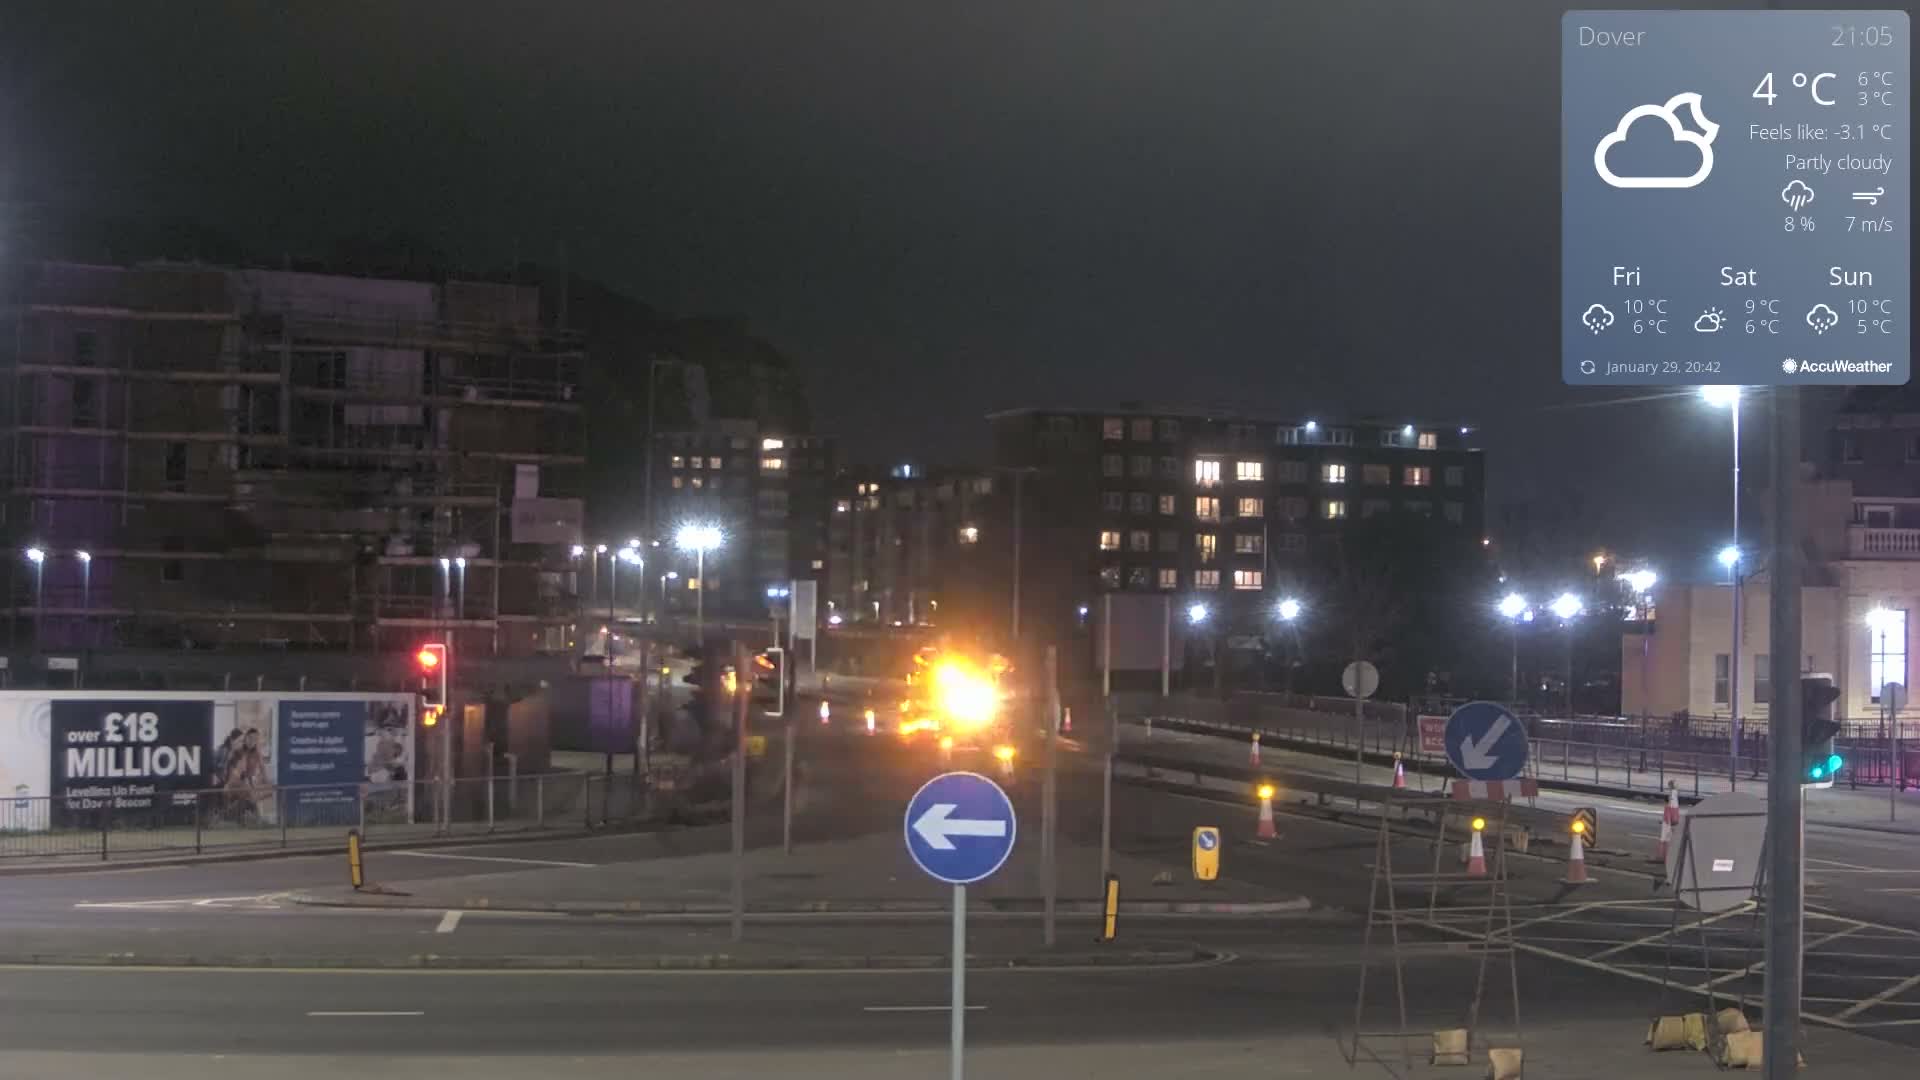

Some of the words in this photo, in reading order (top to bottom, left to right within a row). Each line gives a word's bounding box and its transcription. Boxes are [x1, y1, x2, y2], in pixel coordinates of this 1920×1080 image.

[68, 730, 99, 743] over
[105, 712, 158, 742] £18
[67, 746, 201, 777] MILLION
